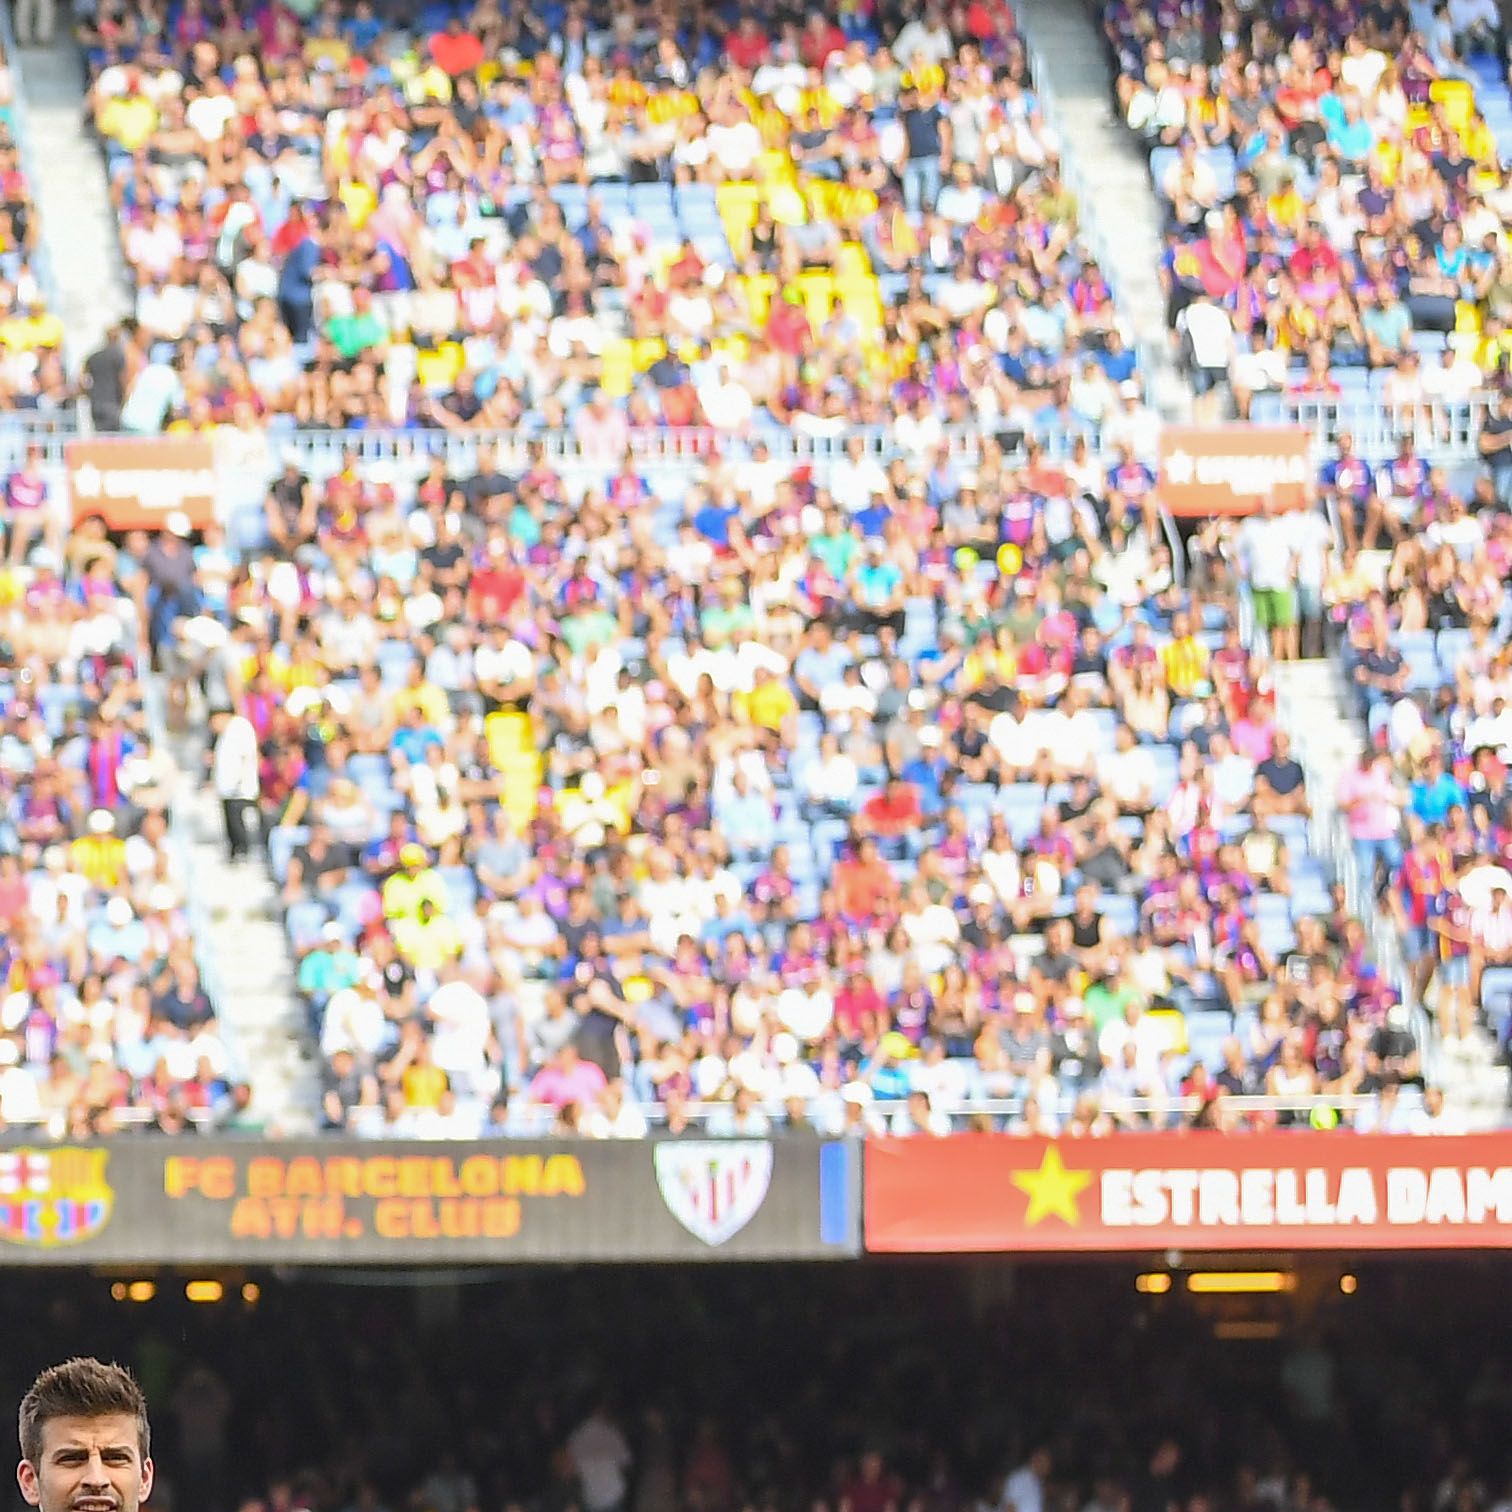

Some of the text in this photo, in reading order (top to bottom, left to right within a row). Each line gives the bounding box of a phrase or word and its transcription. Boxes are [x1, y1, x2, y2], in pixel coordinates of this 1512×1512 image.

[165, 1155, 585, 1198] FC BARCELONA
[1100, 1166, 1376, 1226] ESTRELLA
[375, 1197, 522, 1238] CLUB
